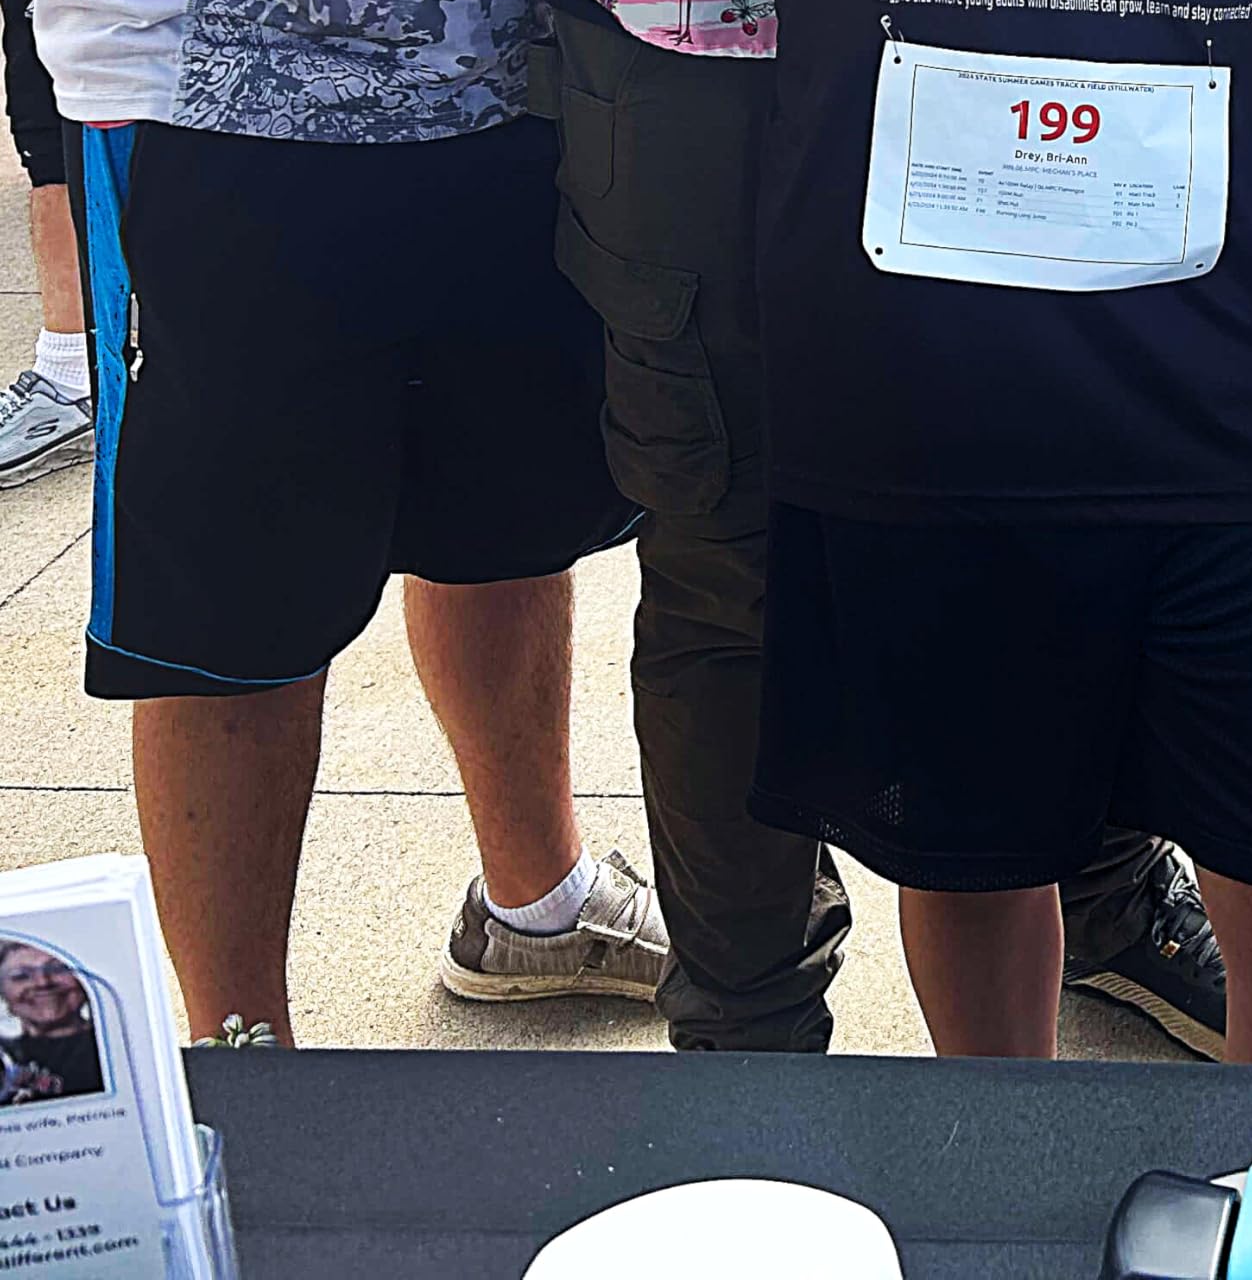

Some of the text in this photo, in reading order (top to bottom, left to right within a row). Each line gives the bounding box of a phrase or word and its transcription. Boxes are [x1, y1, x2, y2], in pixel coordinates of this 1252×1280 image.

[1119, 0, 1145, 17] grow,
[1172, 3, 1189, 19] and
[1191, 4, 1212, 25] stay
[975, 74, 996, 83] STATE
[999, 77, 1028, 85] SUMMER
[1030, 78, 1055, 87] GAMES
[1056, 81, 1079, 89] TRACK
[1087, 82, 1106, 91] FIELD
[1108, 84, 1155, 93] (STILLWATER)
[1010, 100, 1101, 144] 199
[1015, 150, 1088, 165] Drey, Bri-Ann
